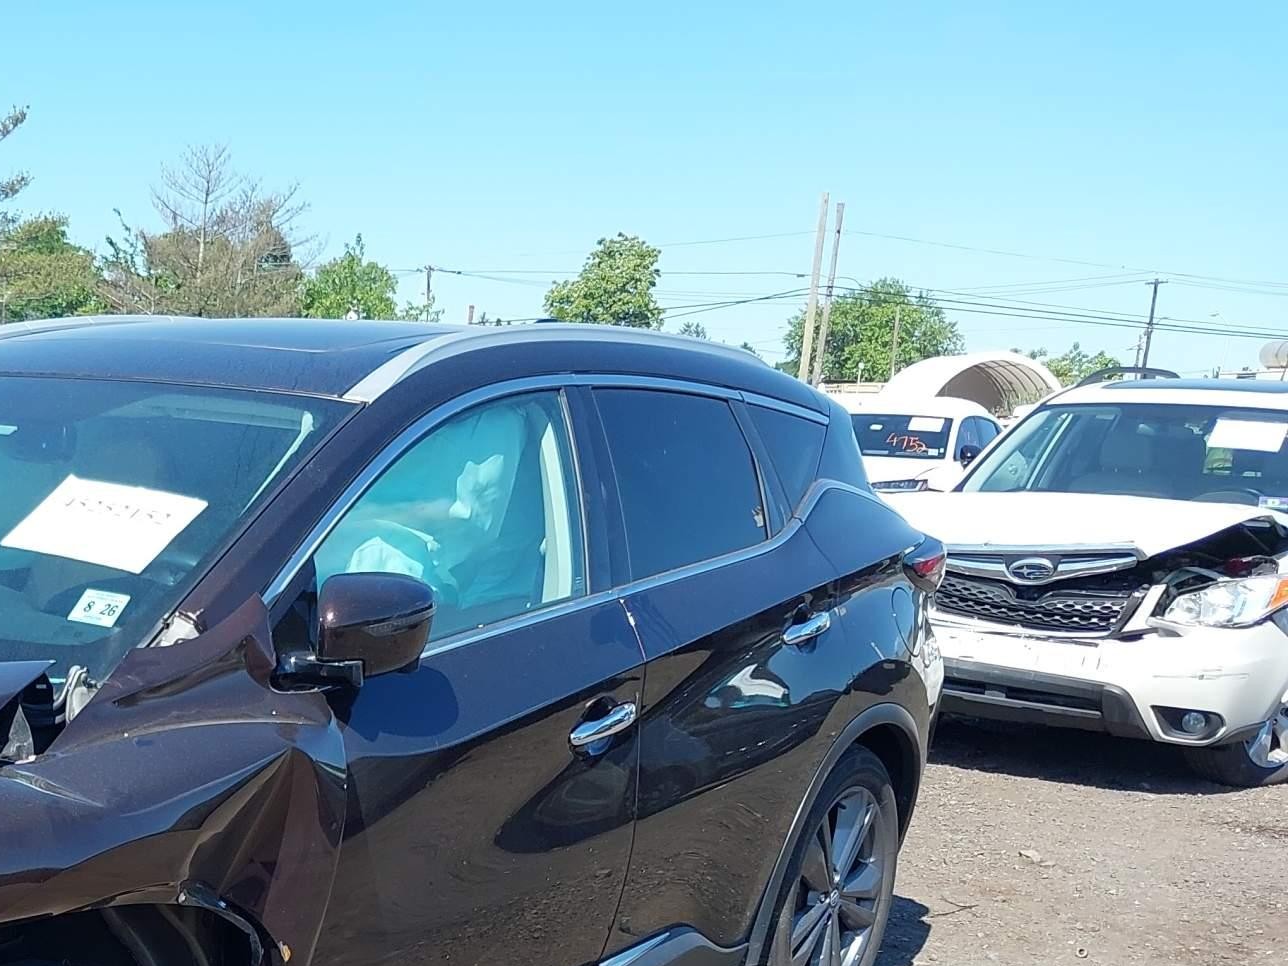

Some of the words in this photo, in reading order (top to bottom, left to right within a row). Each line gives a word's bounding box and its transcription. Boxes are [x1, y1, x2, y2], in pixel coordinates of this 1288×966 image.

[886, 432, 928, 453] 4752
[83, 600, 96, 613] 8
[98, 603, 120, 617] 26
